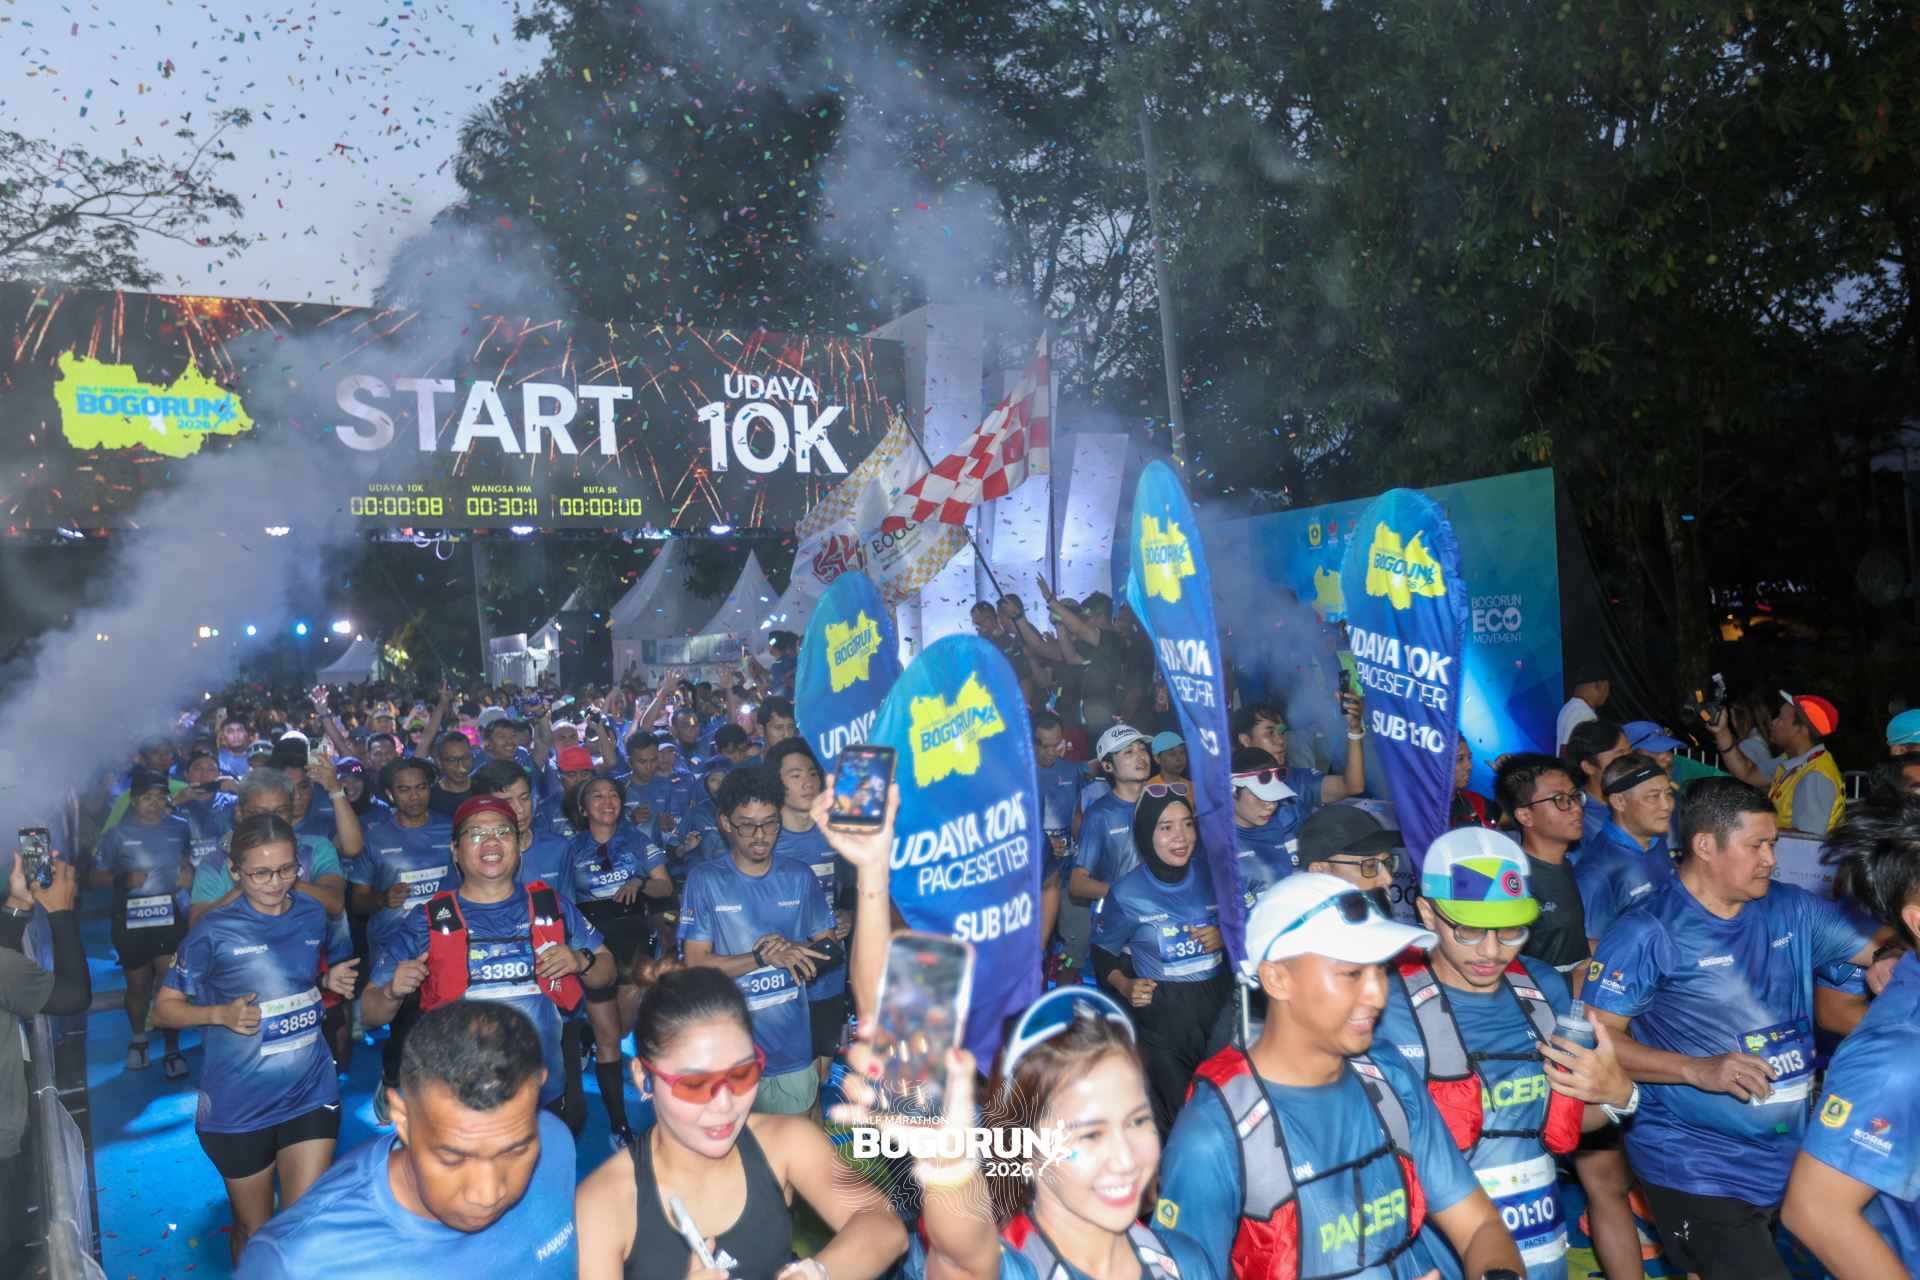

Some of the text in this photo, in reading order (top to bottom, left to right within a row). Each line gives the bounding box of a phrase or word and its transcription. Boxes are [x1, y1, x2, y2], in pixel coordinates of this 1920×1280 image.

[101, 386, 149, 395] MARATHON
[724, 374, 818, 402] UDAYA
[76, 393, 223, 418] BOGORUN
[335, 374, 633, 456] START
[177, 419, 211, 430] 2026
[698, 401, 849, 474] 10K
[369, 484, 424, 493] UDAYA 10K
[472, 485, 532, 494] WANGSA HM
[583, 486, 618, 494] KUTA 5K
[351, 497, 443, 516] 00:00:08
[467, 498, 538, 516] 00:30:11
[560, 498, 642, 516] 00:00:00
[1471, 594, 1522, 609] BOGORUN
[1472, 606, 1522, 633] ECO
[1473, 631, 1523, 644] MOVEMENT
[1404, 645, 1453, 686] 10K
[920, 705, 989, 753] BOGORUN
[1372, 709, 1445, 754] SUB 1:10
[889, 813, 984, 870] UDAYA
[919, 836, 1029, 896] PACESETTER
[414, 881, 440, 896] 3107
[600, 869, 629, 886] 3283
[137, 906, 168, 918] 4040
[952, 906, 1001, 943] SUB
[481, 961, 529, 981] 3380
[1698, 956, 1732, 967] BOGORUN
[751, 973, 786, 993] 3081
[280, 1009, 317, 1035] 3859
[1769, 1049, 1805, 1077] 3113
[1482, 1074, 1547, 1110] ACER
[1320, 1188, 1406, 1253] PACER
[1502, 1196, 1554, 1230] 01:10
[537, 1221, 574, 1262] NAWANA
[1524, 1236, 1548, 1249] PACER
